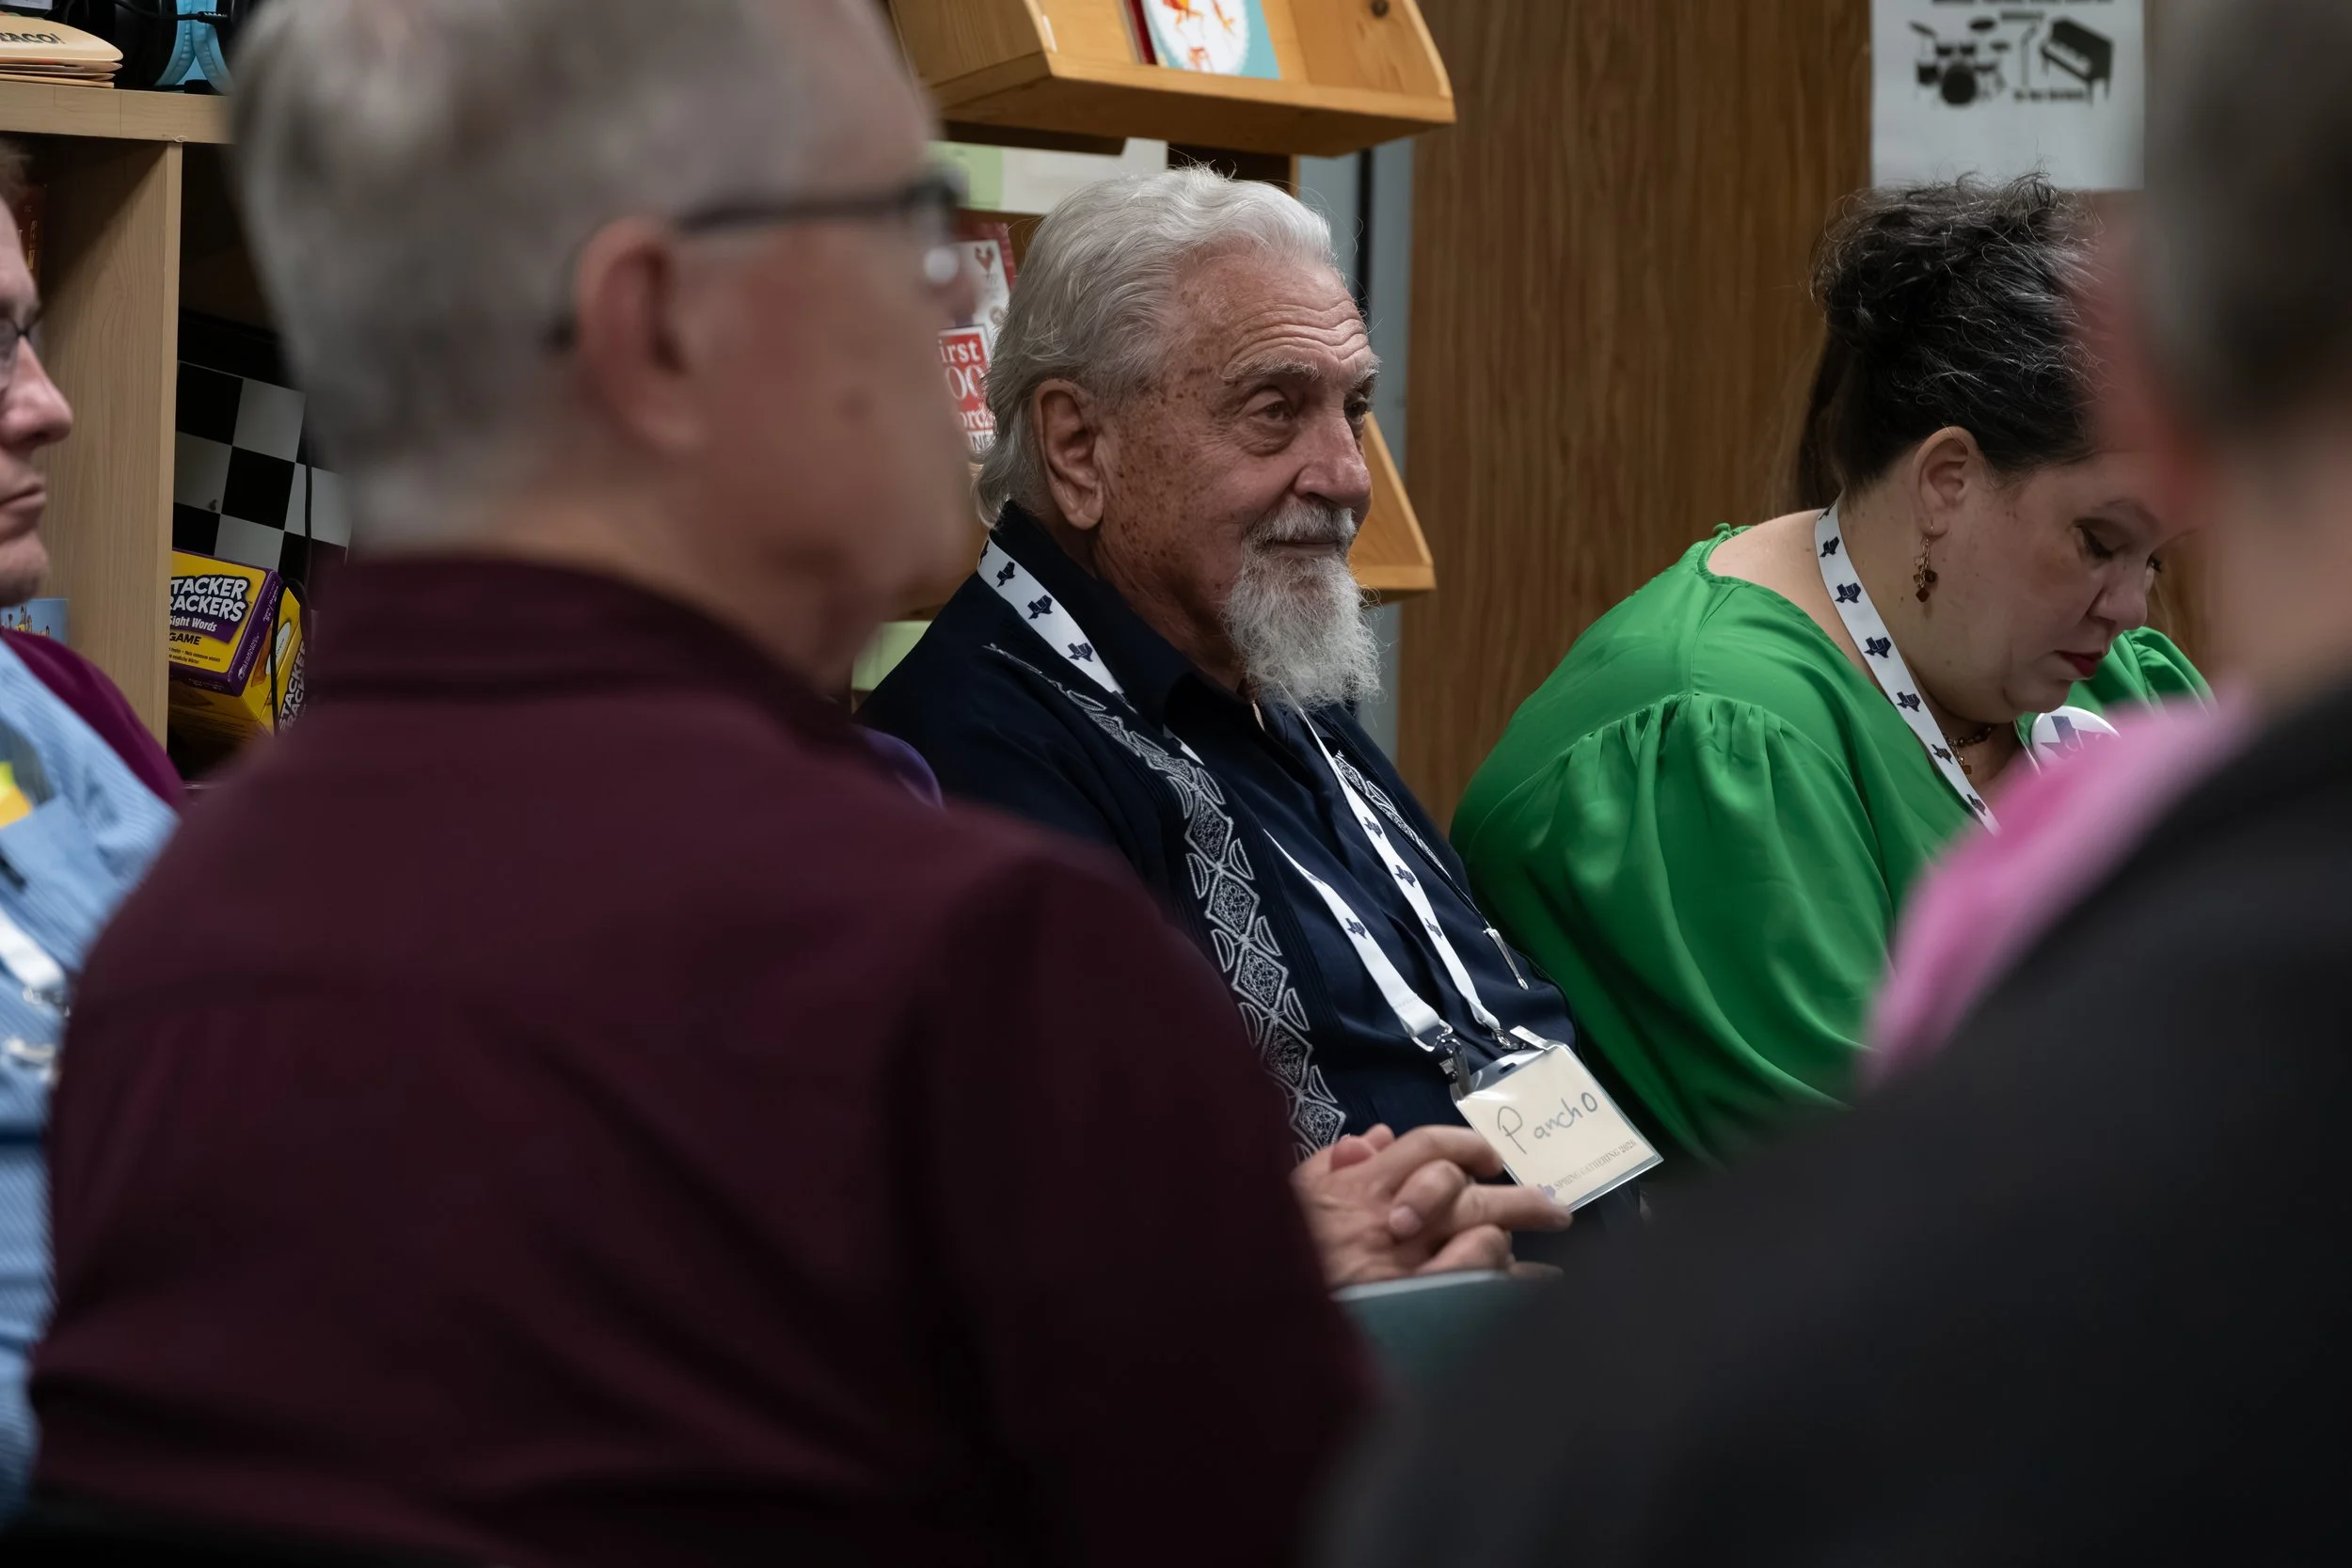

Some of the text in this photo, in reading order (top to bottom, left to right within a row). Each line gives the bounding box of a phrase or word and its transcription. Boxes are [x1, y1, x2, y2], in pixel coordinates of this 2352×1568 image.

[938, 339, 981, 364] irst
[170, 578, 247, 600] TACKER
[192, 617, 217, 632] Words
[168, 632, 201, 645] GAME
[1553, 1170, 1581, 1190] SPRING
[1580, 1149, 1620, 1176] GATHERING
